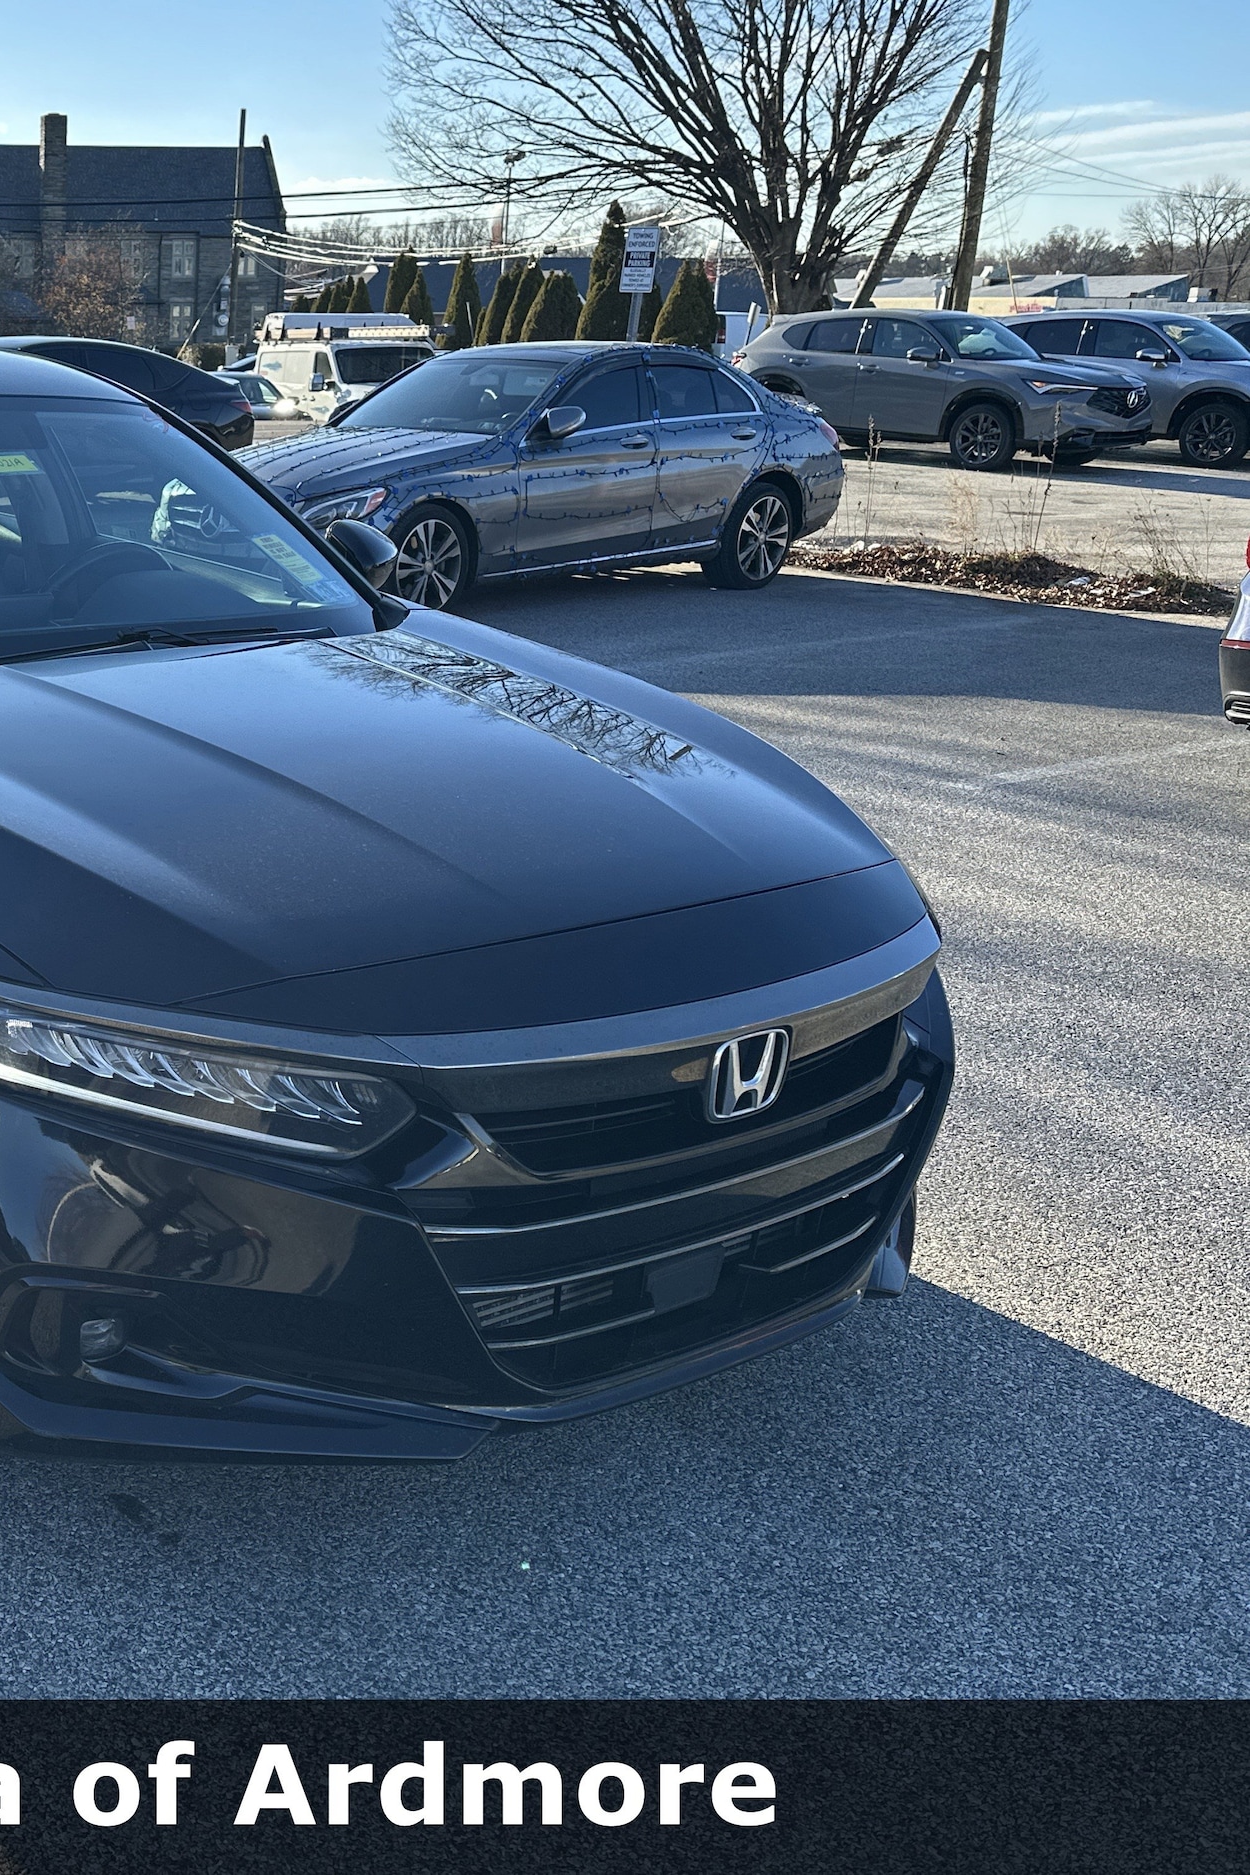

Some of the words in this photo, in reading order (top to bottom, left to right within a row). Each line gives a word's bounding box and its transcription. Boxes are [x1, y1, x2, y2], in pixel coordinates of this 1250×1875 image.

[633, 232, 654, 240] TOWING
[628, 240, 656, 248] ENFORCED
[627, 259, 651, 267] PARKING
